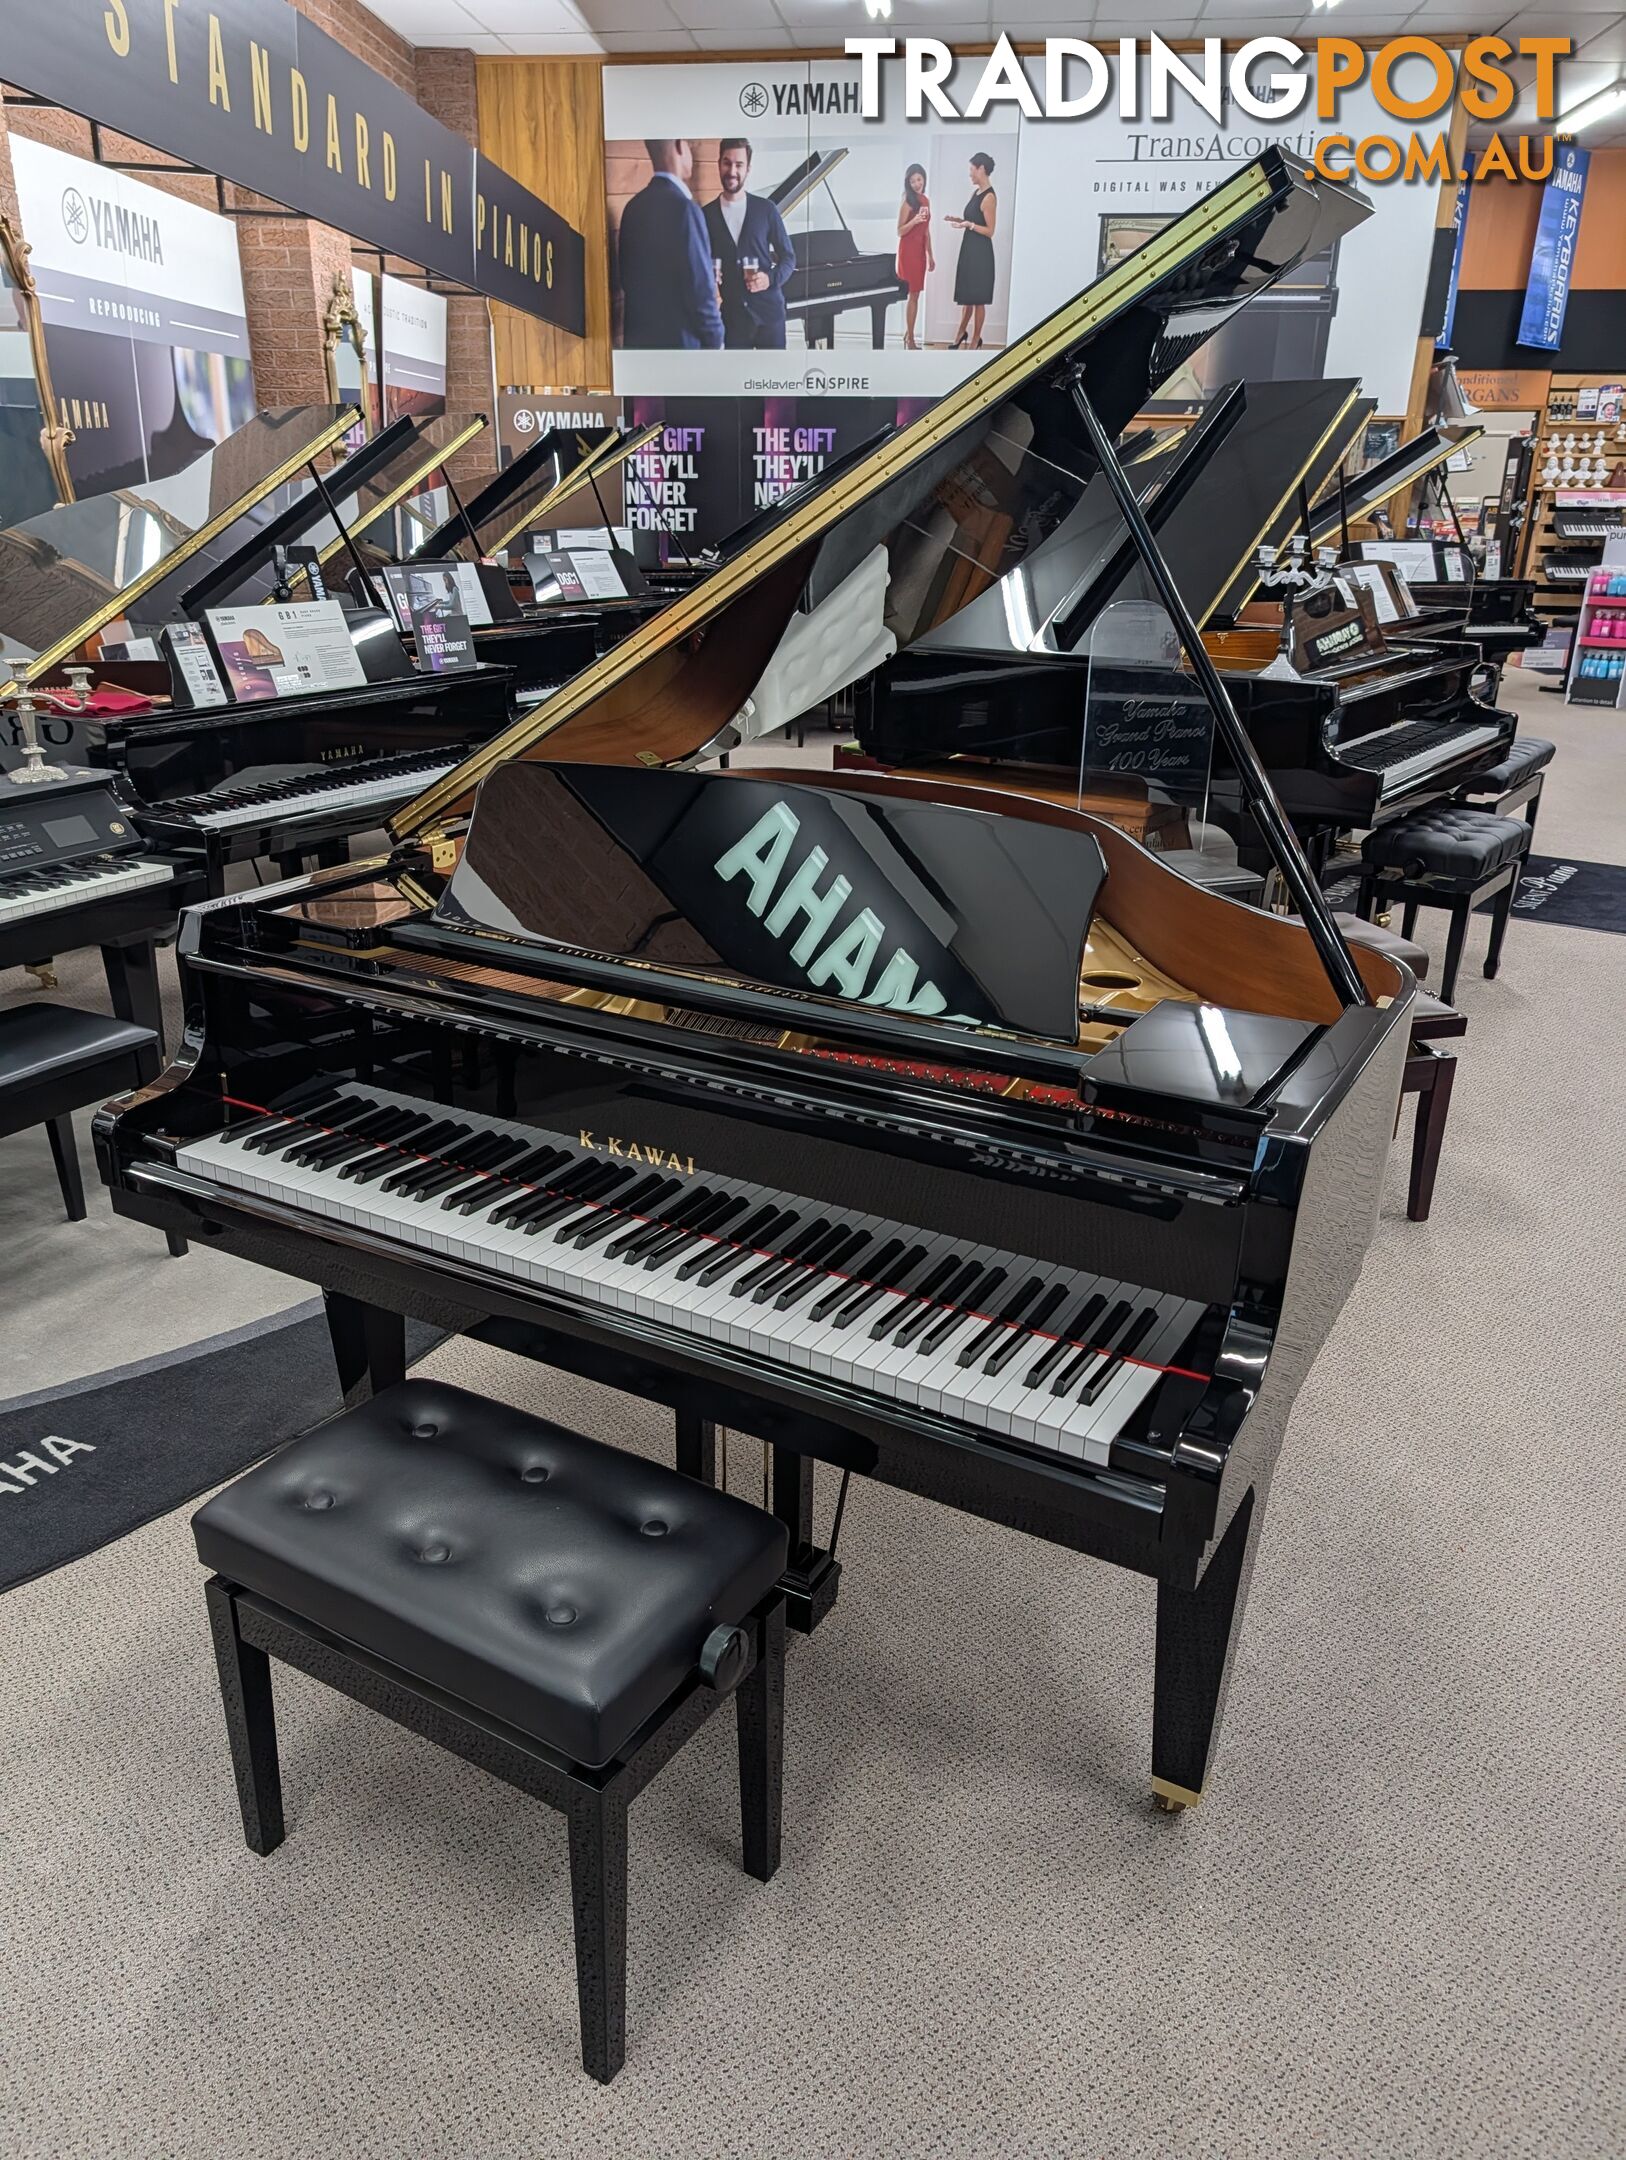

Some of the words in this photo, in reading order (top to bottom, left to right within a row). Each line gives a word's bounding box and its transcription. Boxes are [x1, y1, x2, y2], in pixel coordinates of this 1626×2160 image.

[772, 82, 863, 116] YAMAH
[1093, 182, 1150, 193] DIGITAL
[1159, 181, 1187, 192] WAS
[1552, 167, 1583, 195] YAMAHA
[88, 196, 164, 266] YAMAHA
[424, 158, 454, 234] IN
[477, 193, 554, 289] PIANOS
[1547, 197, 1581, 345] KEYBOARDS
[88, 297, 161, 328] REPRODUCING
[744, 378, 803, 391] disklavier
[805, 376, 870, 390] ENSPIRE
[535, 411, 605, 433] YAMAHA
[663, 427, 706, 452] GIFT
[752, 428, 790, 452] THE
[793, 427, 837, 452] GIFT
[626, 454, 699, 479] THEY'LL
[626, 481, 686, 505] NEVER
[626, 508, 698, 532] FORGET
[320, 744, 364, 761] YAMAHA
[1109, 751, 1147, 771] 100
